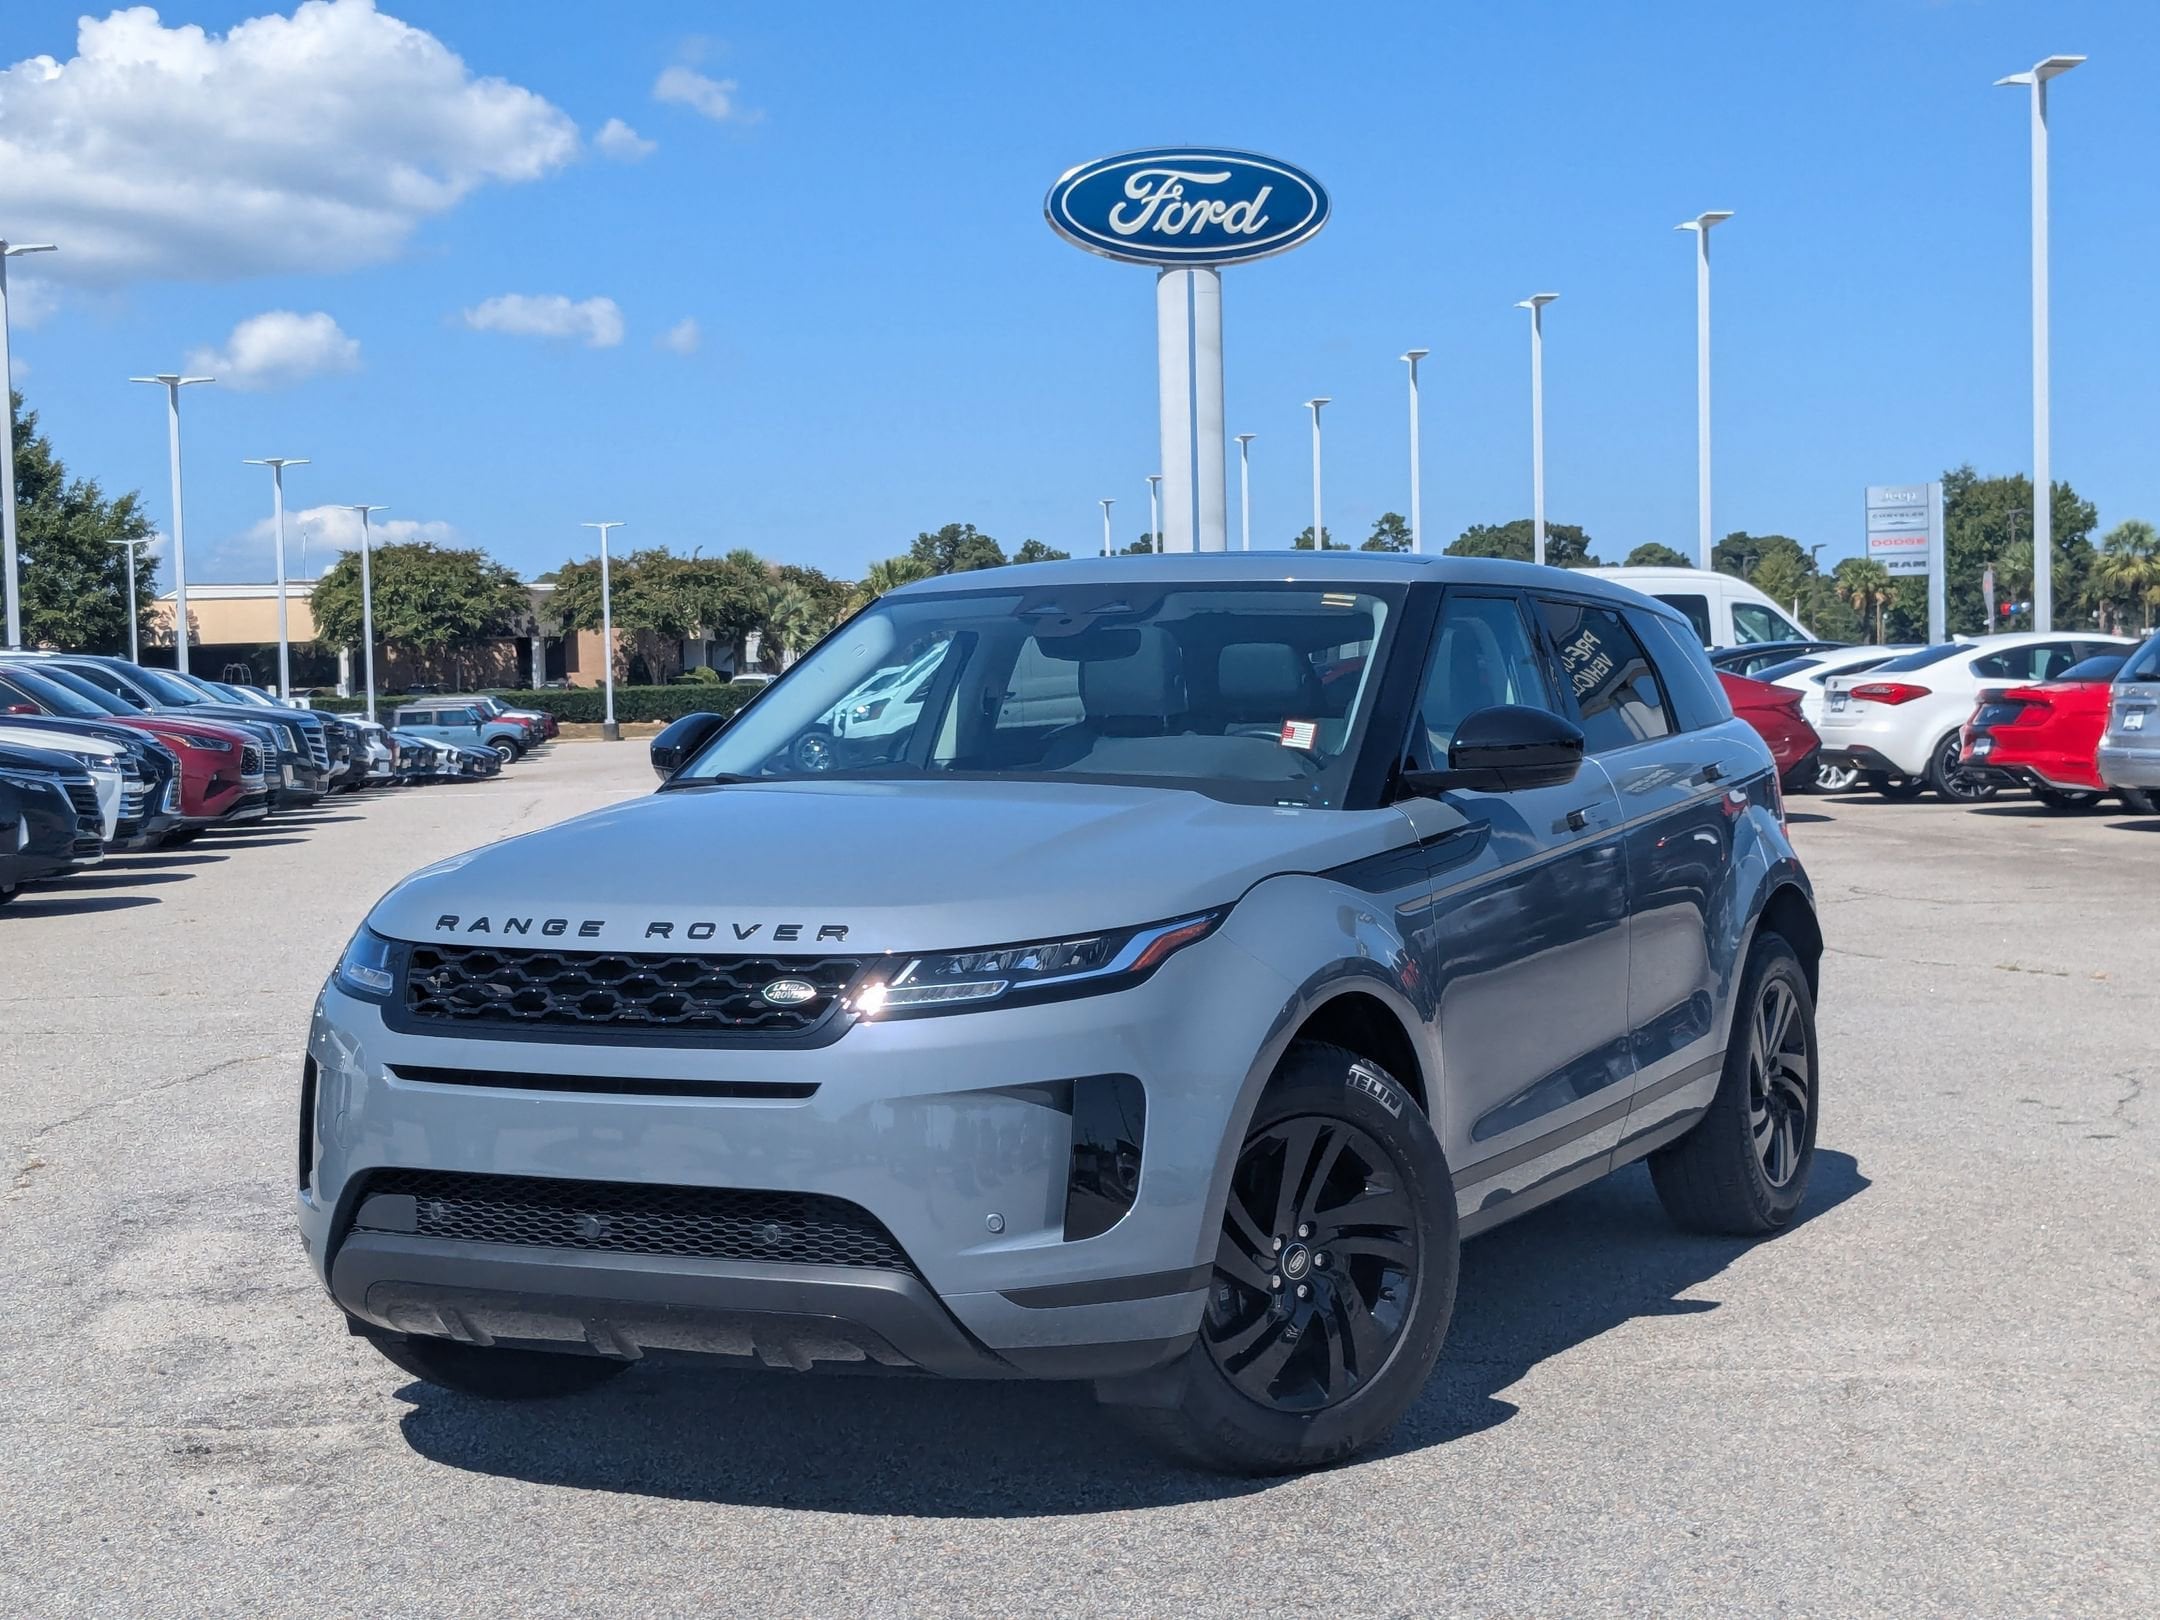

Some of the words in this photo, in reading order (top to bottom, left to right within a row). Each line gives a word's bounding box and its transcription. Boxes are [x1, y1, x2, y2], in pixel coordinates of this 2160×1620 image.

[1109, 169, 1273, 235] Ford
[1871, 536, 1926, 547] DODGE
[1888, 560, 1926, 568] RAM
[435, 914, 605, 938] RANGE
[645, 921, 850, 942] ROVER
